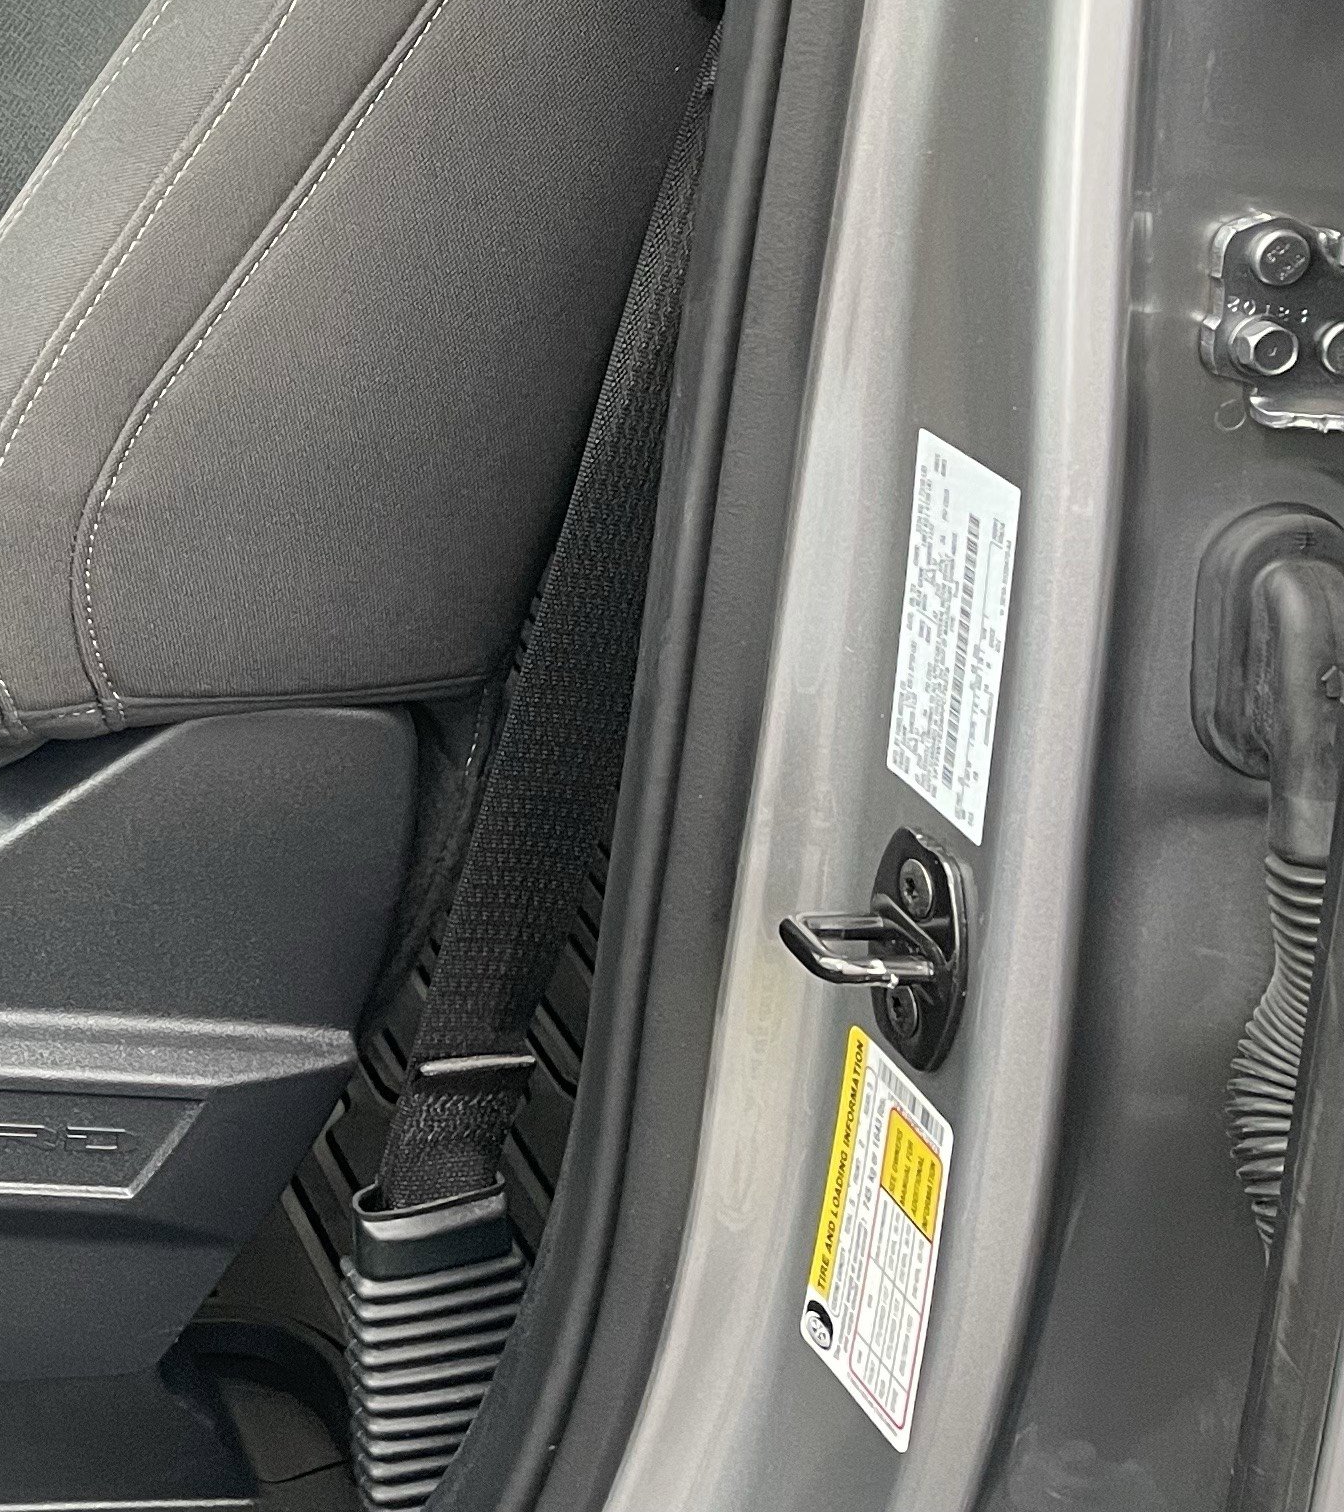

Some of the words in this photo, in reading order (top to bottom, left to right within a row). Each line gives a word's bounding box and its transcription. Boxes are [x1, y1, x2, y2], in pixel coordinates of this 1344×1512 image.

[817, 1253, 830, 1291] TIRE
[825, 1220, 836, 1254] AND
[832, 1150, 848, 1218] LOADING
[843, 1039, 864, 1148] INFORMATION
